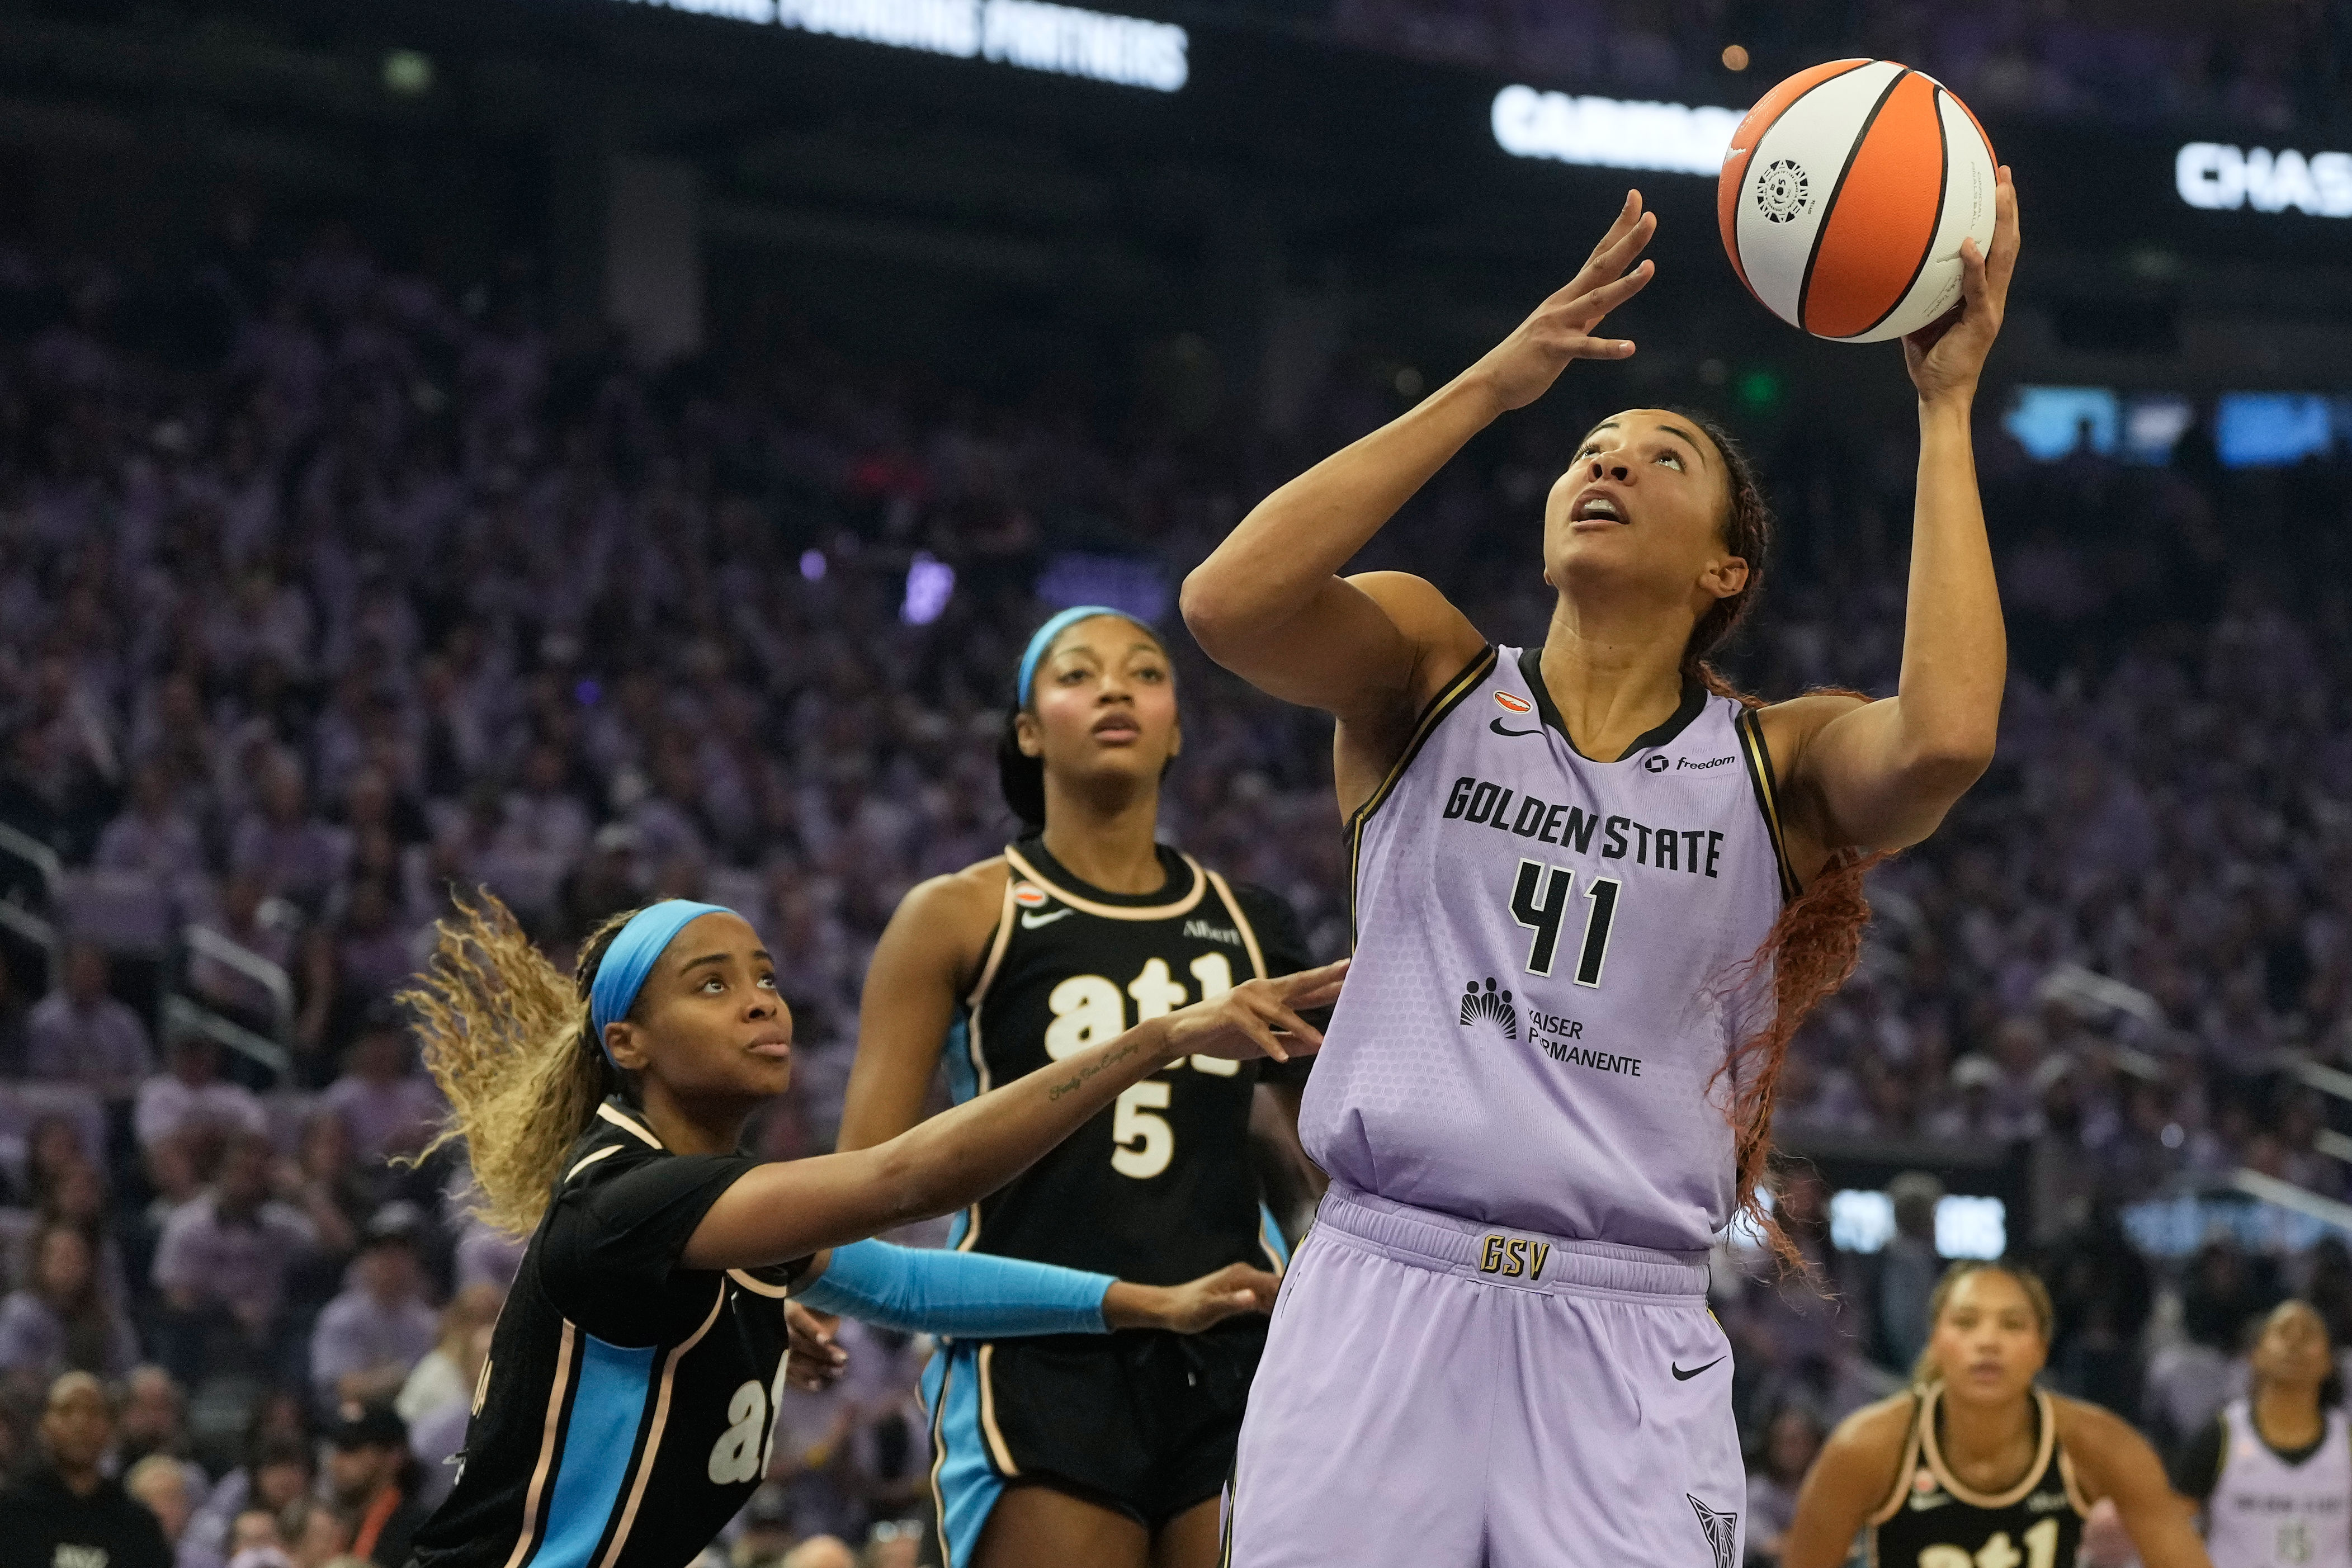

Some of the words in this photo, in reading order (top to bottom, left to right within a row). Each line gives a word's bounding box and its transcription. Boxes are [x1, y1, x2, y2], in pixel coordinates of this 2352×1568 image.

[1676, 756, 1735, 770] freedom
[1443, 777, 1599, 857] GOLDEN
[1601, 815, 1724, 879] STATE
[1508, 857, 1622, 989] 41
[1528, 1027, 1642, 1077] PRMANENTE
[1111, 1081, 1173, 1179] 5
[1480, 1234, 1550, 1281] GSV
